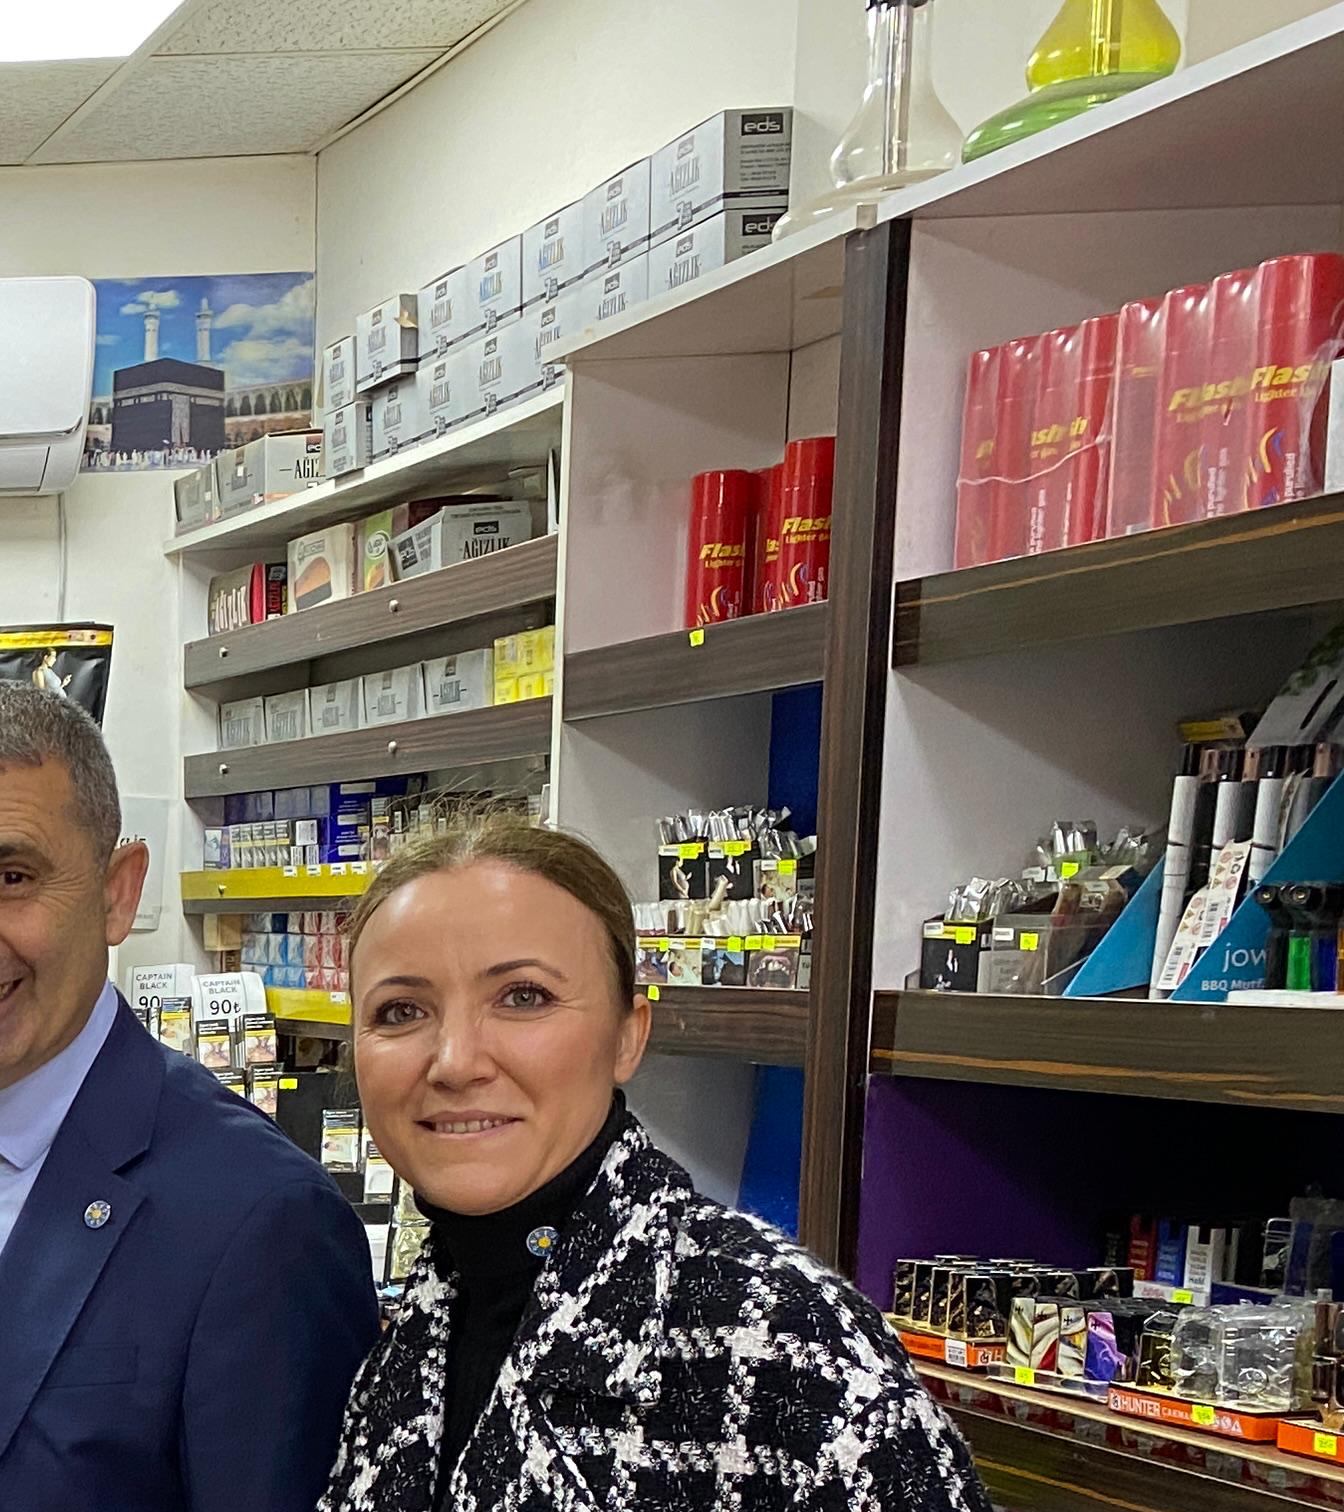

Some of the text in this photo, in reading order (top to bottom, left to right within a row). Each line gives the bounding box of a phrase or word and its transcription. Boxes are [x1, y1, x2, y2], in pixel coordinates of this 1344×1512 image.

[744, 117, 779, 131] eds
[136, 973, 173, 981] CAPTAIN
[140, 981, 168, 989] BLACK
[202, 978, 241, 988] CAPTAIN
[1201, 980, 1228, 992] BBQ
[208, 985, 238, 995] BLACK
[139, 996, 160, 1009] 90
[1121, 1396, 1160, 1416] HUNTER
